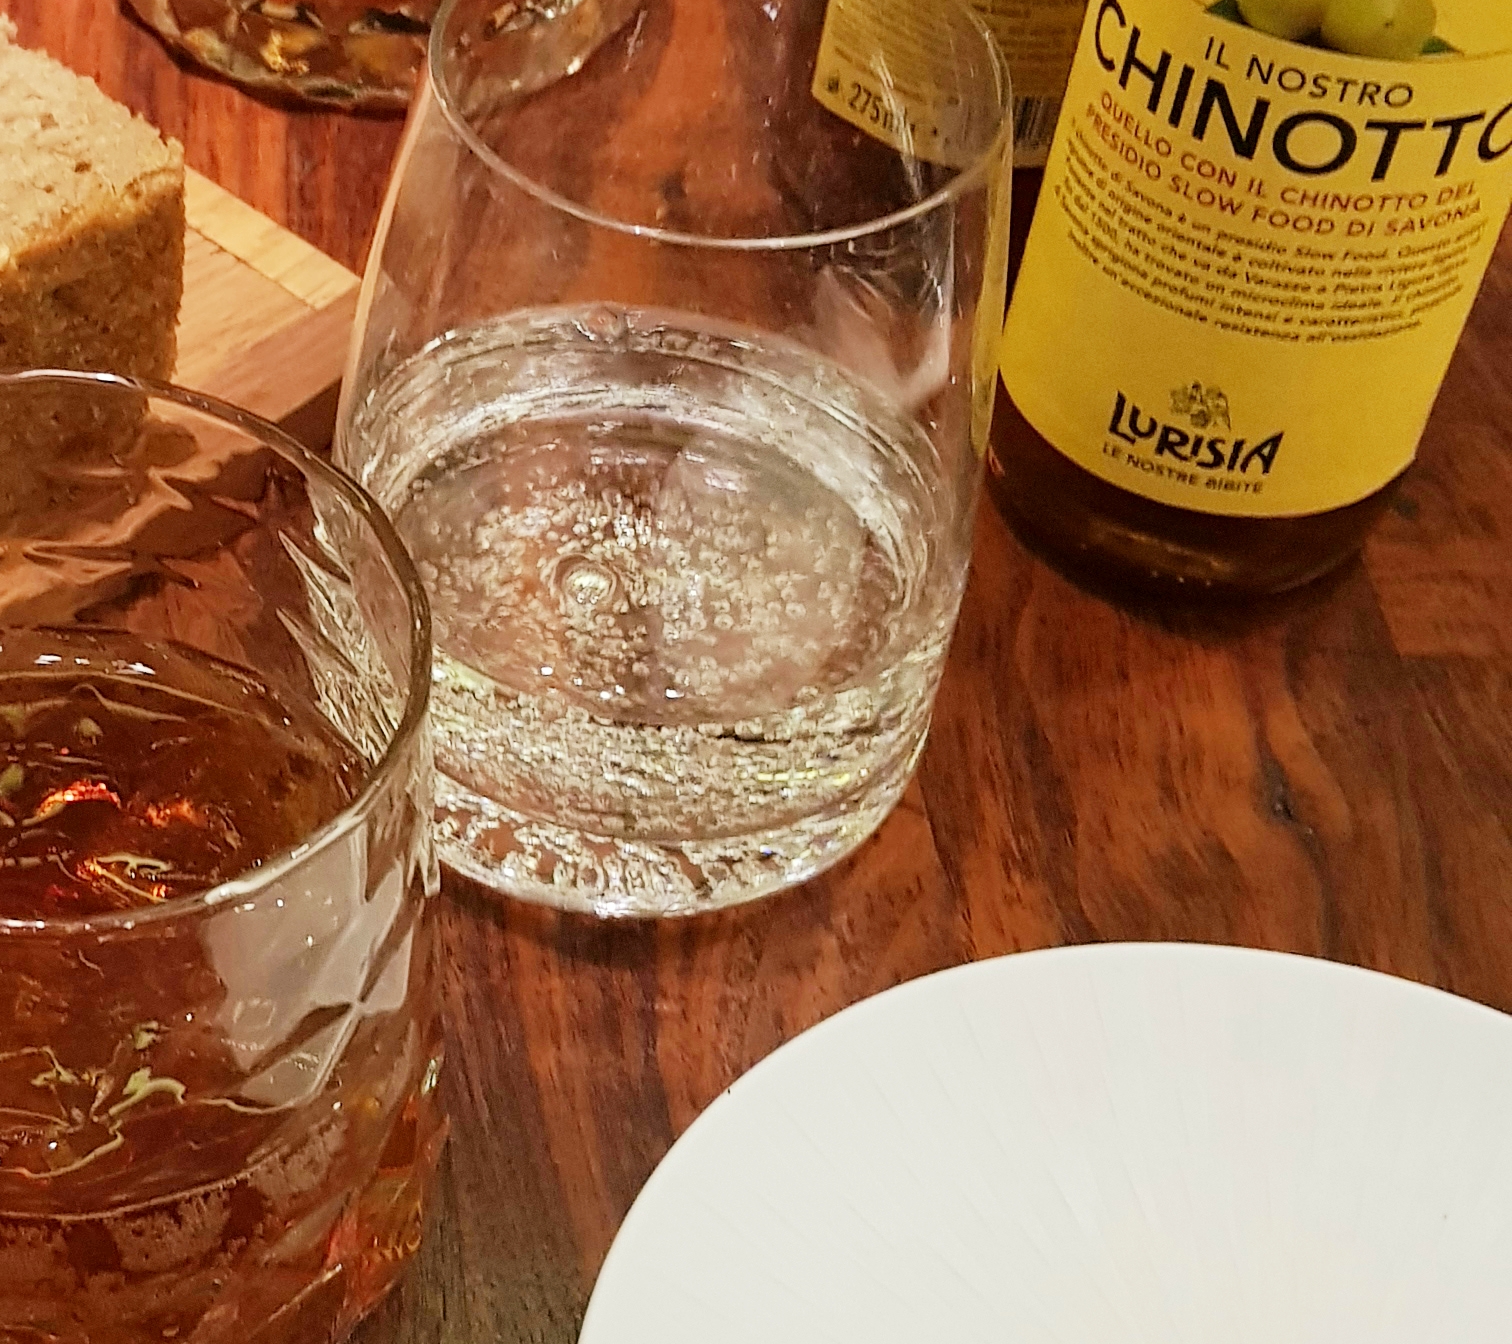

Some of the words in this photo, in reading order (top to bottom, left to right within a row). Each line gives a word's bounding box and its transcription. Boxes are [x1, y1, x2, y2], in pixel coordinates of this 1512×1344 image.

[1205, 36, 1229, 70] IL
[1246, 54, 1413, 108] NOSTRO
[1086, 102, 1161, 180] PRESIDIO
[1169, 174, 1242, 216] SLOW
[1251, 206, 1334, 236] FOOD
[1346, 218, 1375, 237] DI
[1384, 198, 1481, 236] SAVONA
[1101, 90, 1172, 158] QUELLO
[1180, 152, 1236, 189] CON
[1248, 177, 1265, 198] IL
[1280, 187, 1428, 213] CHINOTTO
[1437, 180, 1476, 205] DEL
[1108, 389, 1284, 475] LURISIA
[1127, 454, 1198, 486] NOSTRE
